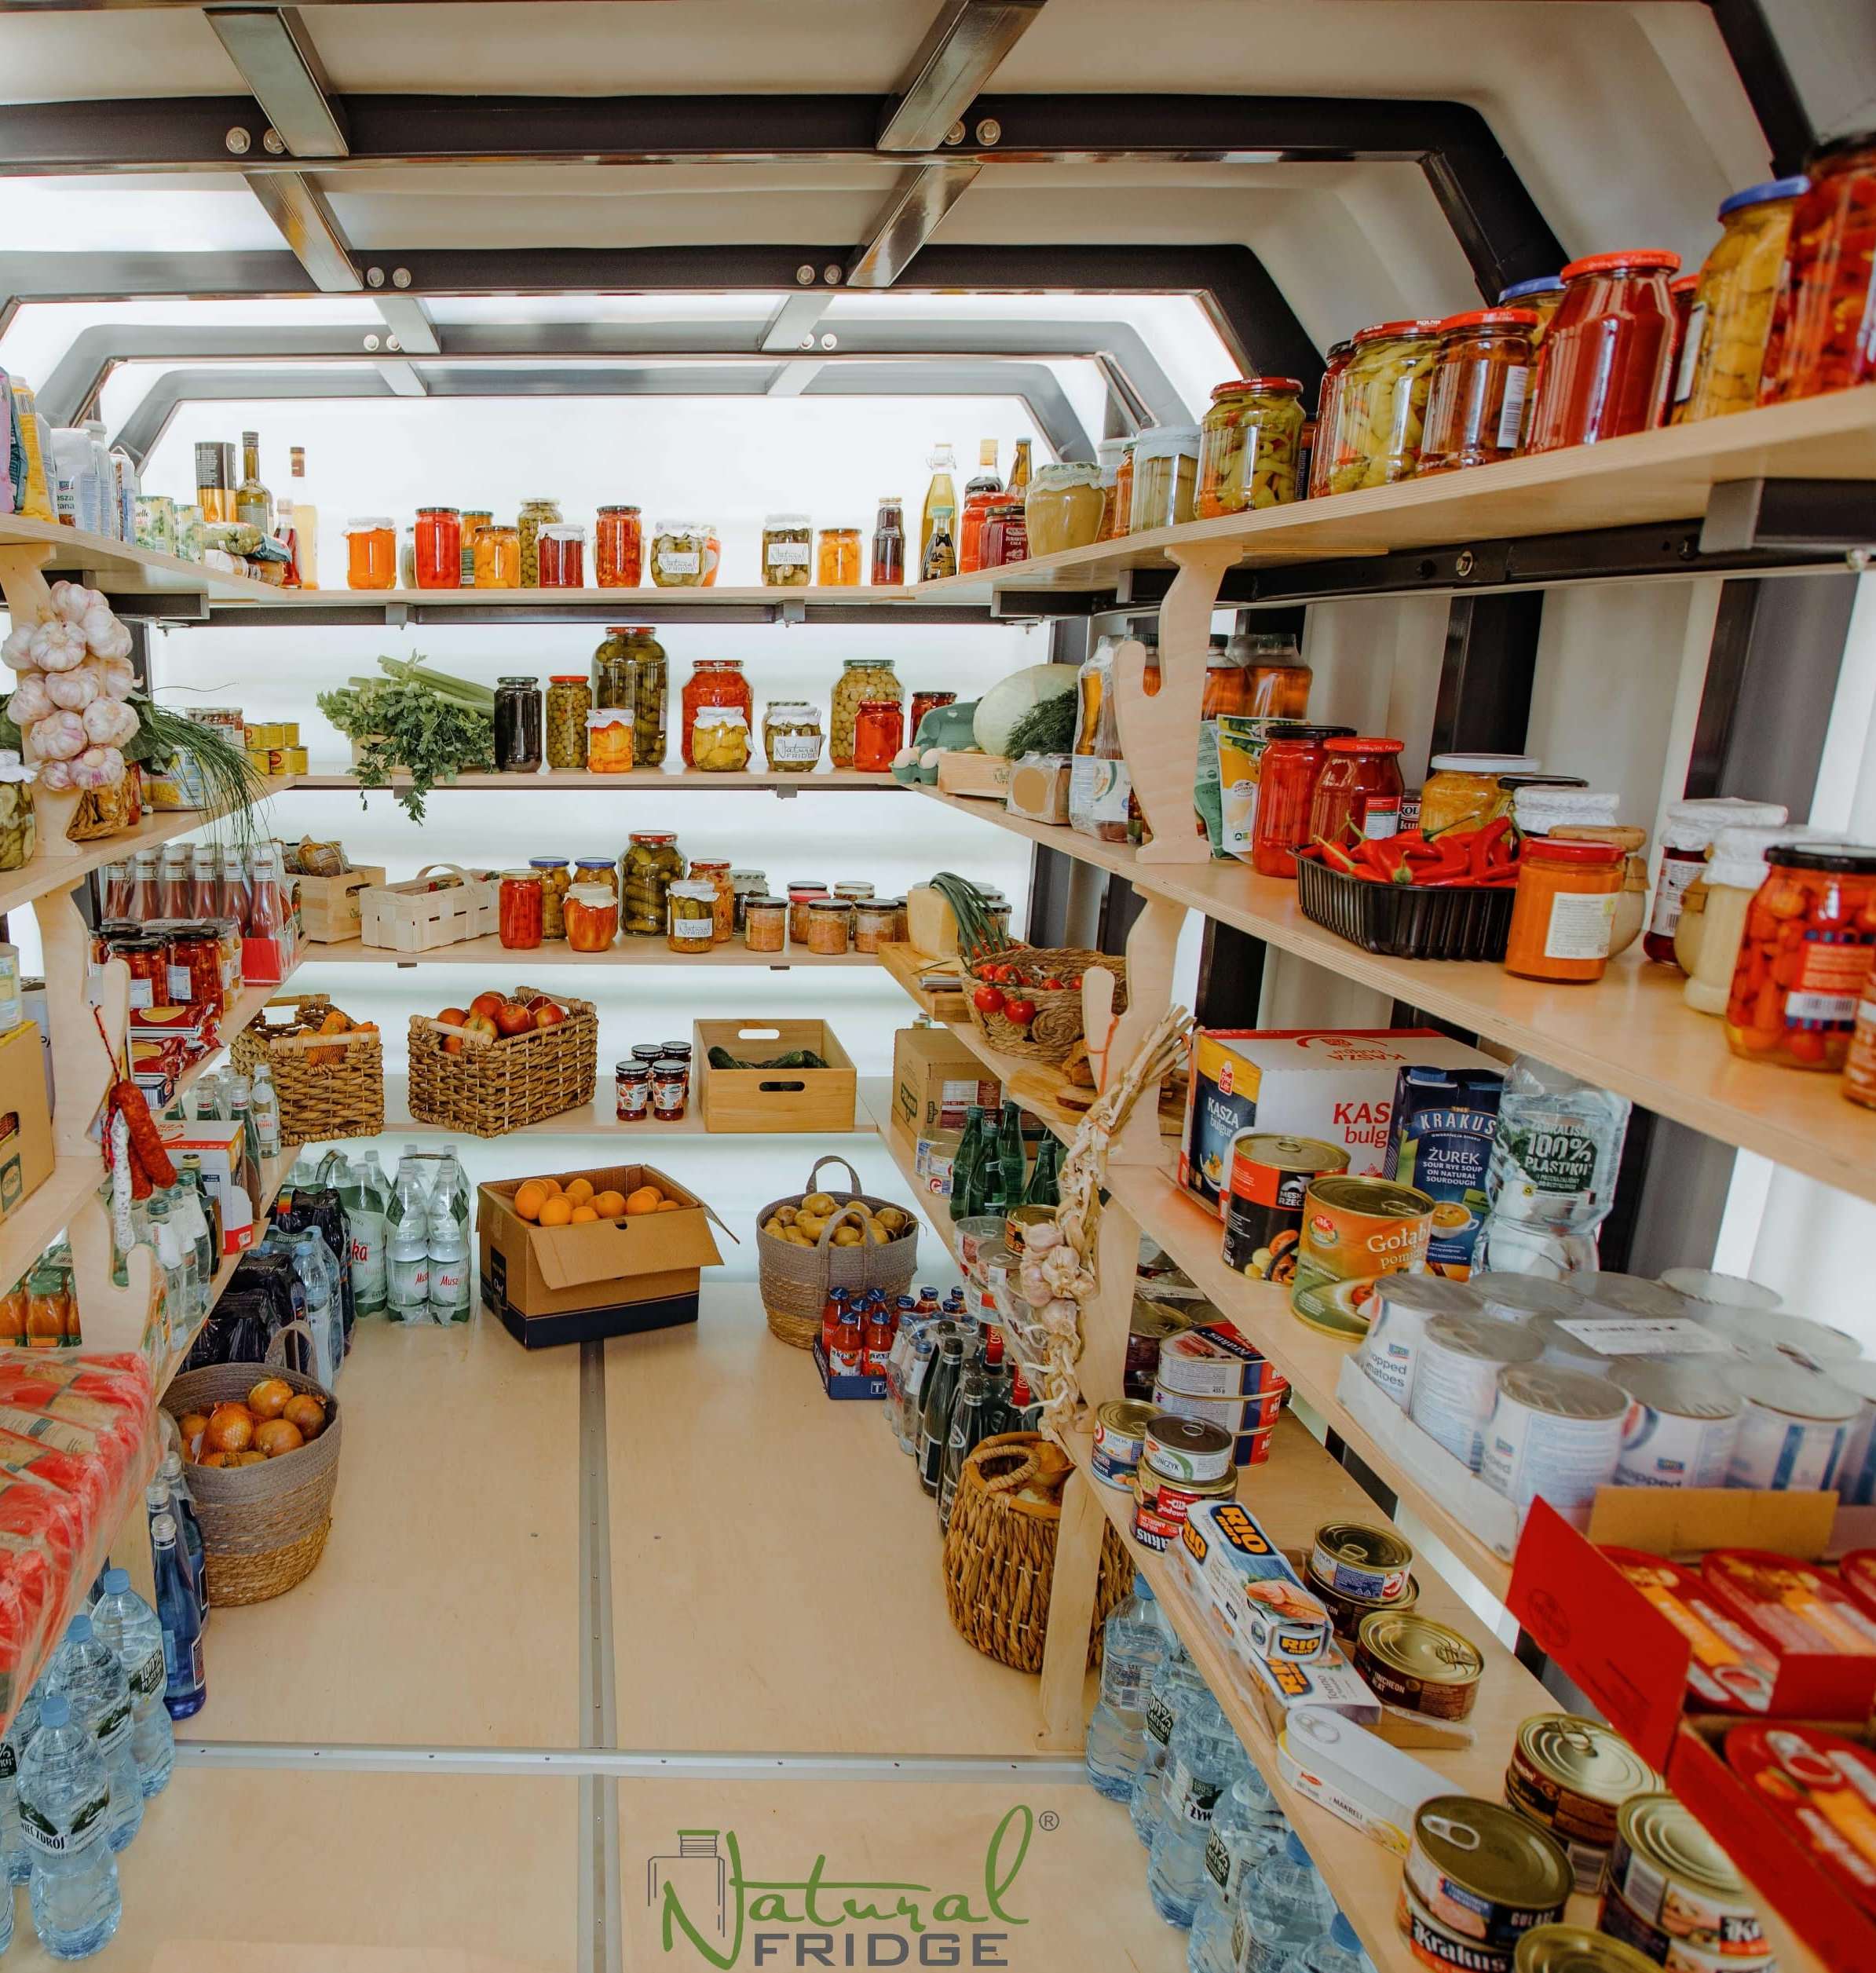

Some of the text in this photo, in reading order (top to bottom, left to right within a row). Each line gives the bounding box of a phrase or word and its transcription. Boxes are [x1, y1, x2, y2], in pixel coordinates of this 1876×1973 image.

[775, 739, 818, 758] Natural
[1206, 1096, 1240, 1129] KASZA
[1333, 1102, 1391, 1125] KAS
[1419, 1111, 1497, 1136] KRAKUS
[1209, 1116, 1234, 1138] bulgur
[1344, 1125, 1389, 1149] bulg
[1427, 1146, 1481, 1166] ŻUREK
[1527, 1134, 1592, 1163] 100%
[1422, 1160, 1443, 1170] SOUR
[1445, 1163, 1461, 1171] RYE
[1426, 1168, 1477, 1180] ON NATURAL
[1425, 1175, 1477, 1187] SOURDOUGH
[1219, 1506, 1268, 1555] RIO
[1281, 1637, 1320, 1649] RIO
[1413, 1919, 1507, 1972] Krakus
